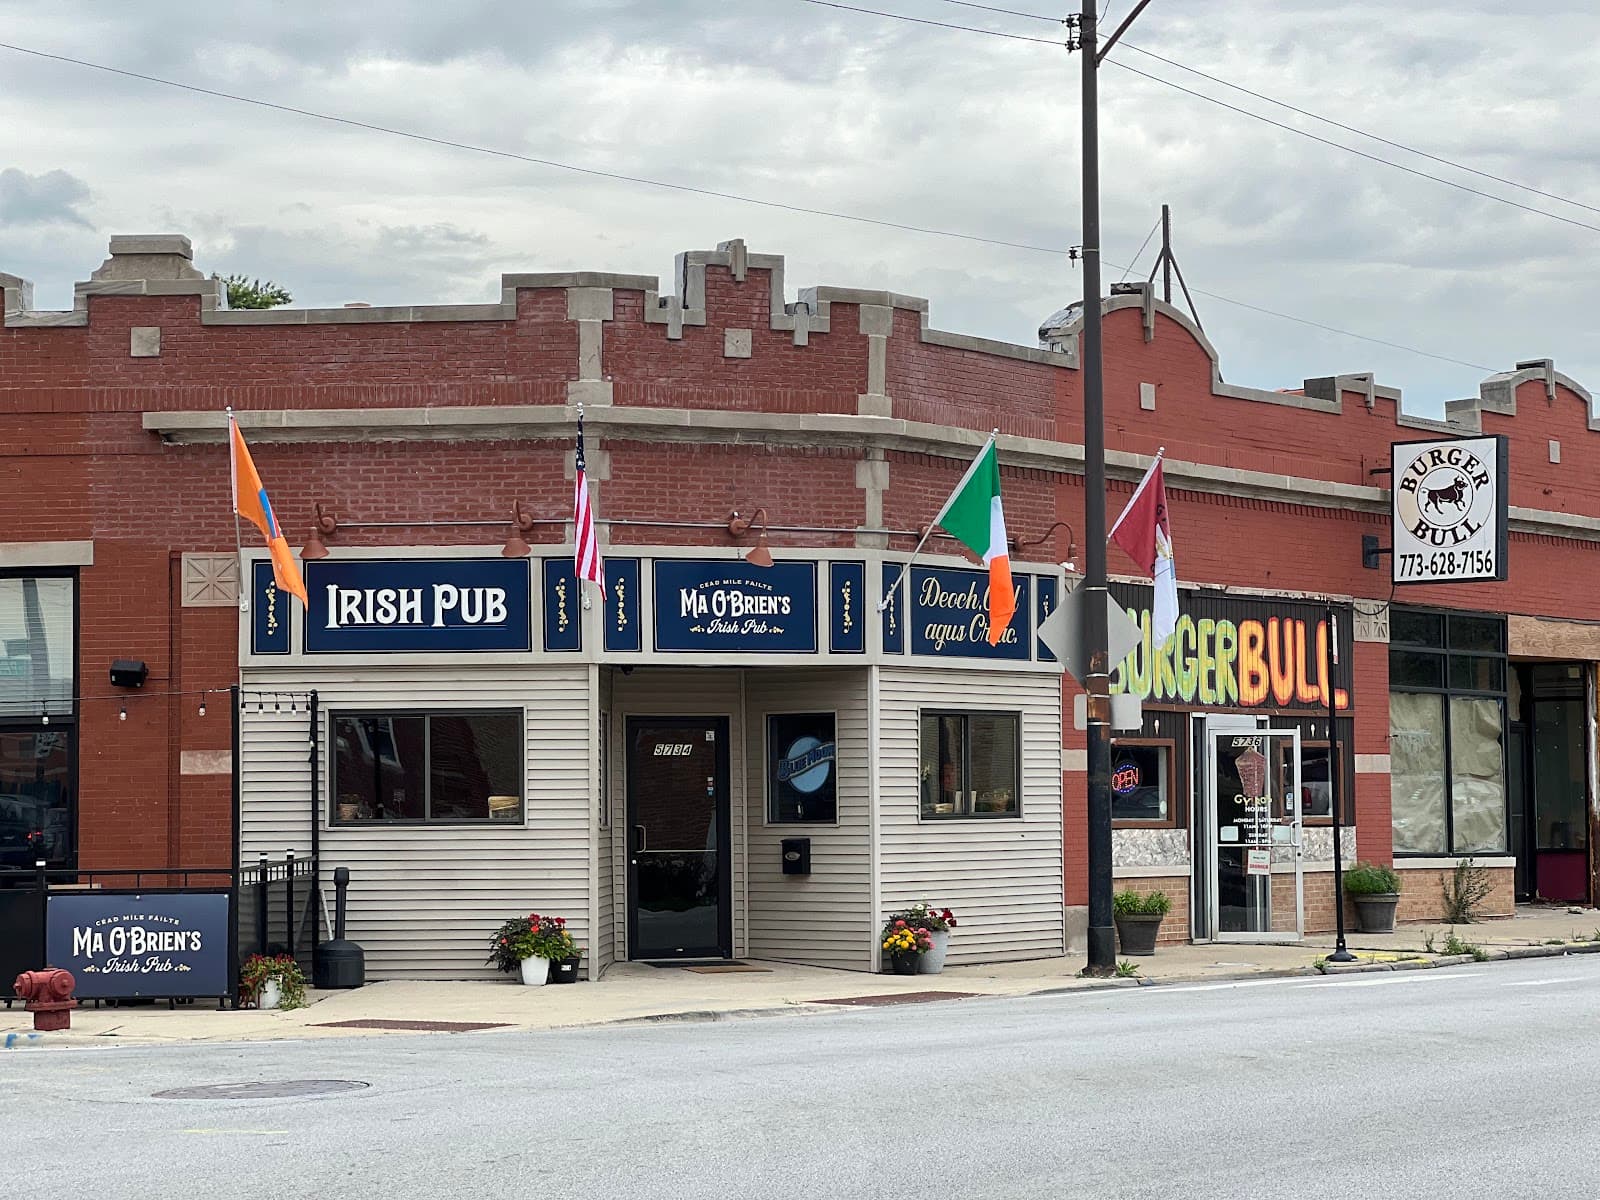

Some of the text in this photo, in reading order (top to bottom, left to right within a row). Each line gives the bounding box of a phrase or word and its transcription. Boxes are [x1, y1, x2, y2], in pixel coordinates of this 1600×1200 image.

[1400, 448, 1490, 494] BURGER
[1410, 518, 1482, 546] BULL
[1399, 549, 1493, 577] 773-628-7156
[325, 584, 508, 628] IRISH PUB
[706, 618, 768, 635] Irish Pub
[924, 622, 967, 651] agus
[1237, 616, 1349, 710] BULL
[654, 744, 693, 756] 5734
[1233, 737, 1261, 746] 5736
[1111, 767, 1139, 791] OPEN
[101, 956, 173, 974] Irish Pub
